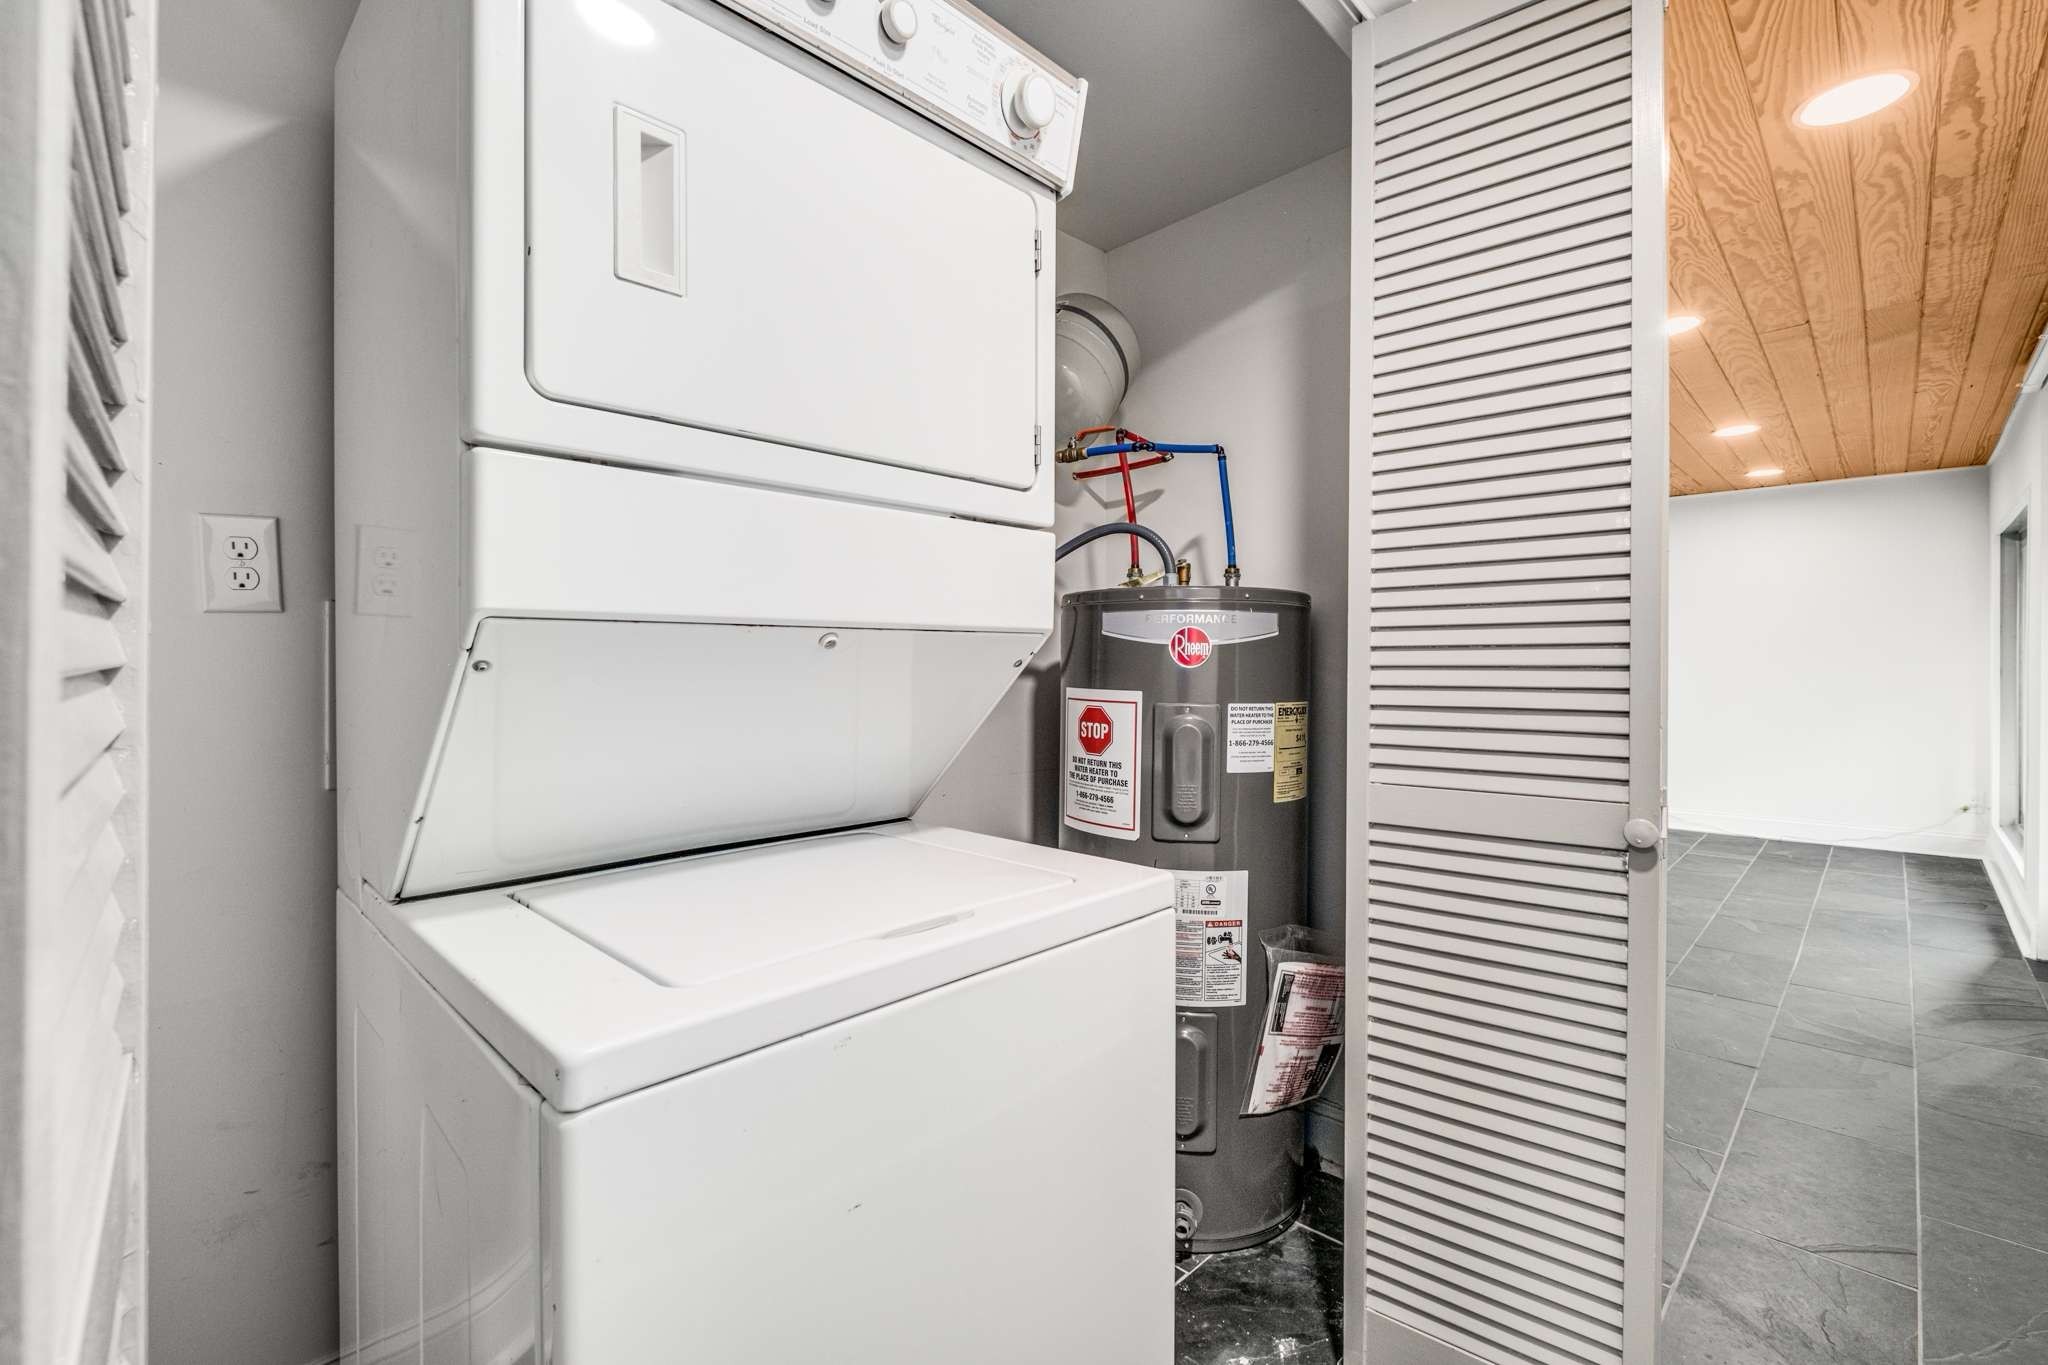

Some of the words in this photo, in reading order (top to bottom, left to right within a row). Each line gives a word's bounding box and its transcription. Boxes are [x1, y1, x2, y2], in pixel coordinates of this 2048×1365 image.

[1145, 613, 1237, 624] PERFORMANCE
[1174, 627, 1209, 661] Rheem
[1081, 721, 1109, 739] STOP
[1087, 758, 1107, 768] RETURN
[1109, 761, 1122, 770] THIS
[1089, 767, 1109, 777] HEATER
[1110, 770, 1118, 778] TO
[1075, 772, 1089, 782] PLACE
[1090, 775, 1096, 783] OF
[1097, 777, 1128, 788] PURCHASE
[1076, 790, 1114, 804] 1-866-279-4566
